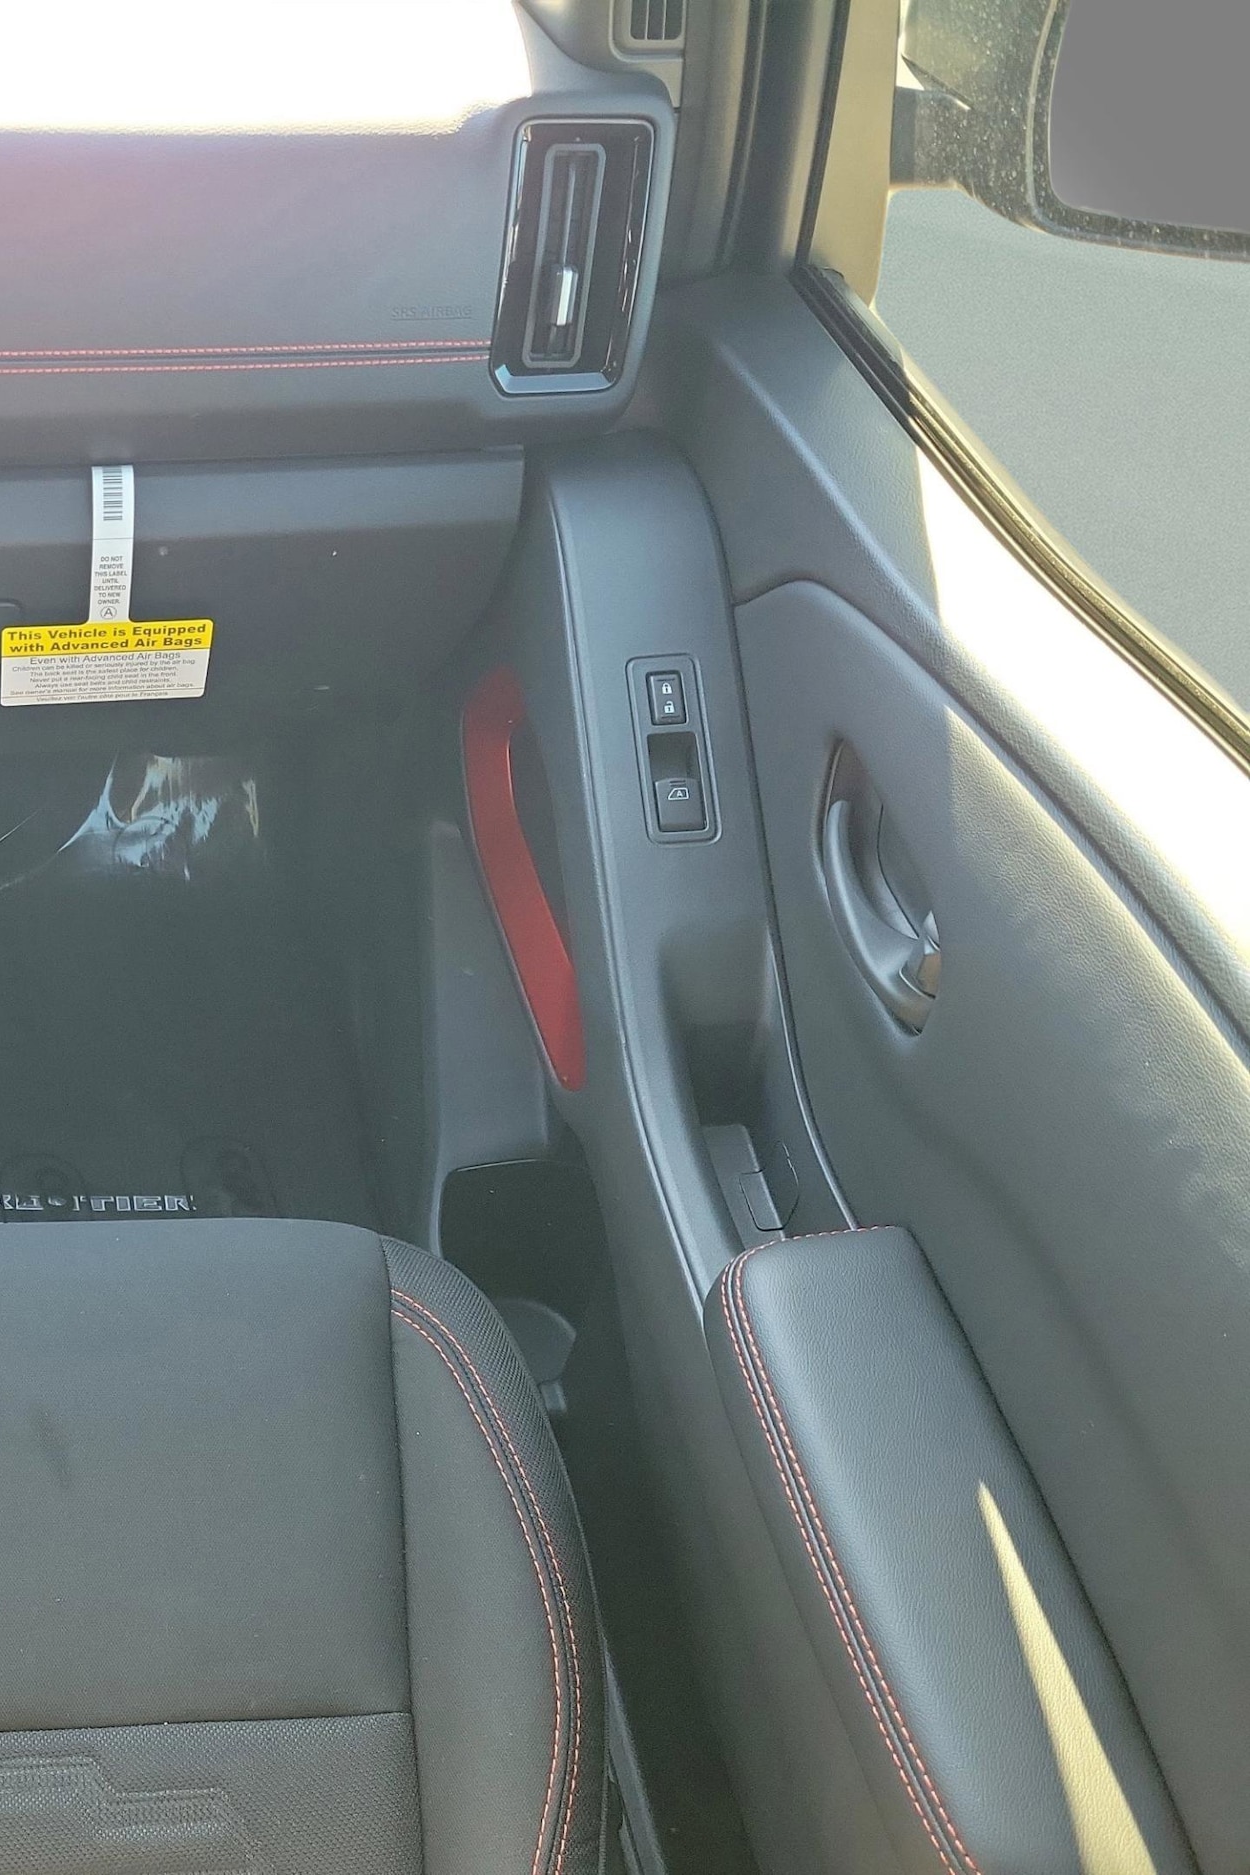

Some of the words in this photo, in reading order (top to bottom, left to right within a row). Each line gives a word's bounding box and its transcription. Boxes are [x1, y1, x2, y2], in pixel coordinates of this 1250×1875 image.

[7, 630, 42, 641] This
[48, 628, 107, 640] Vehicle
[113, 627, 126, 637] is
[132, 624, 206, 637] Equipped
[10, 643, 44, 653] with
[50, 639, 129, 651] Advanced
[134, 638, 158, 648] Air
[163, 637, 202, 648] Bags
[30, 657, 56, 665] Even
[83, 653, 134, 662] Advanced
[137, 652, 153, 661] Air
[155, 651, 181, 660] Bags
